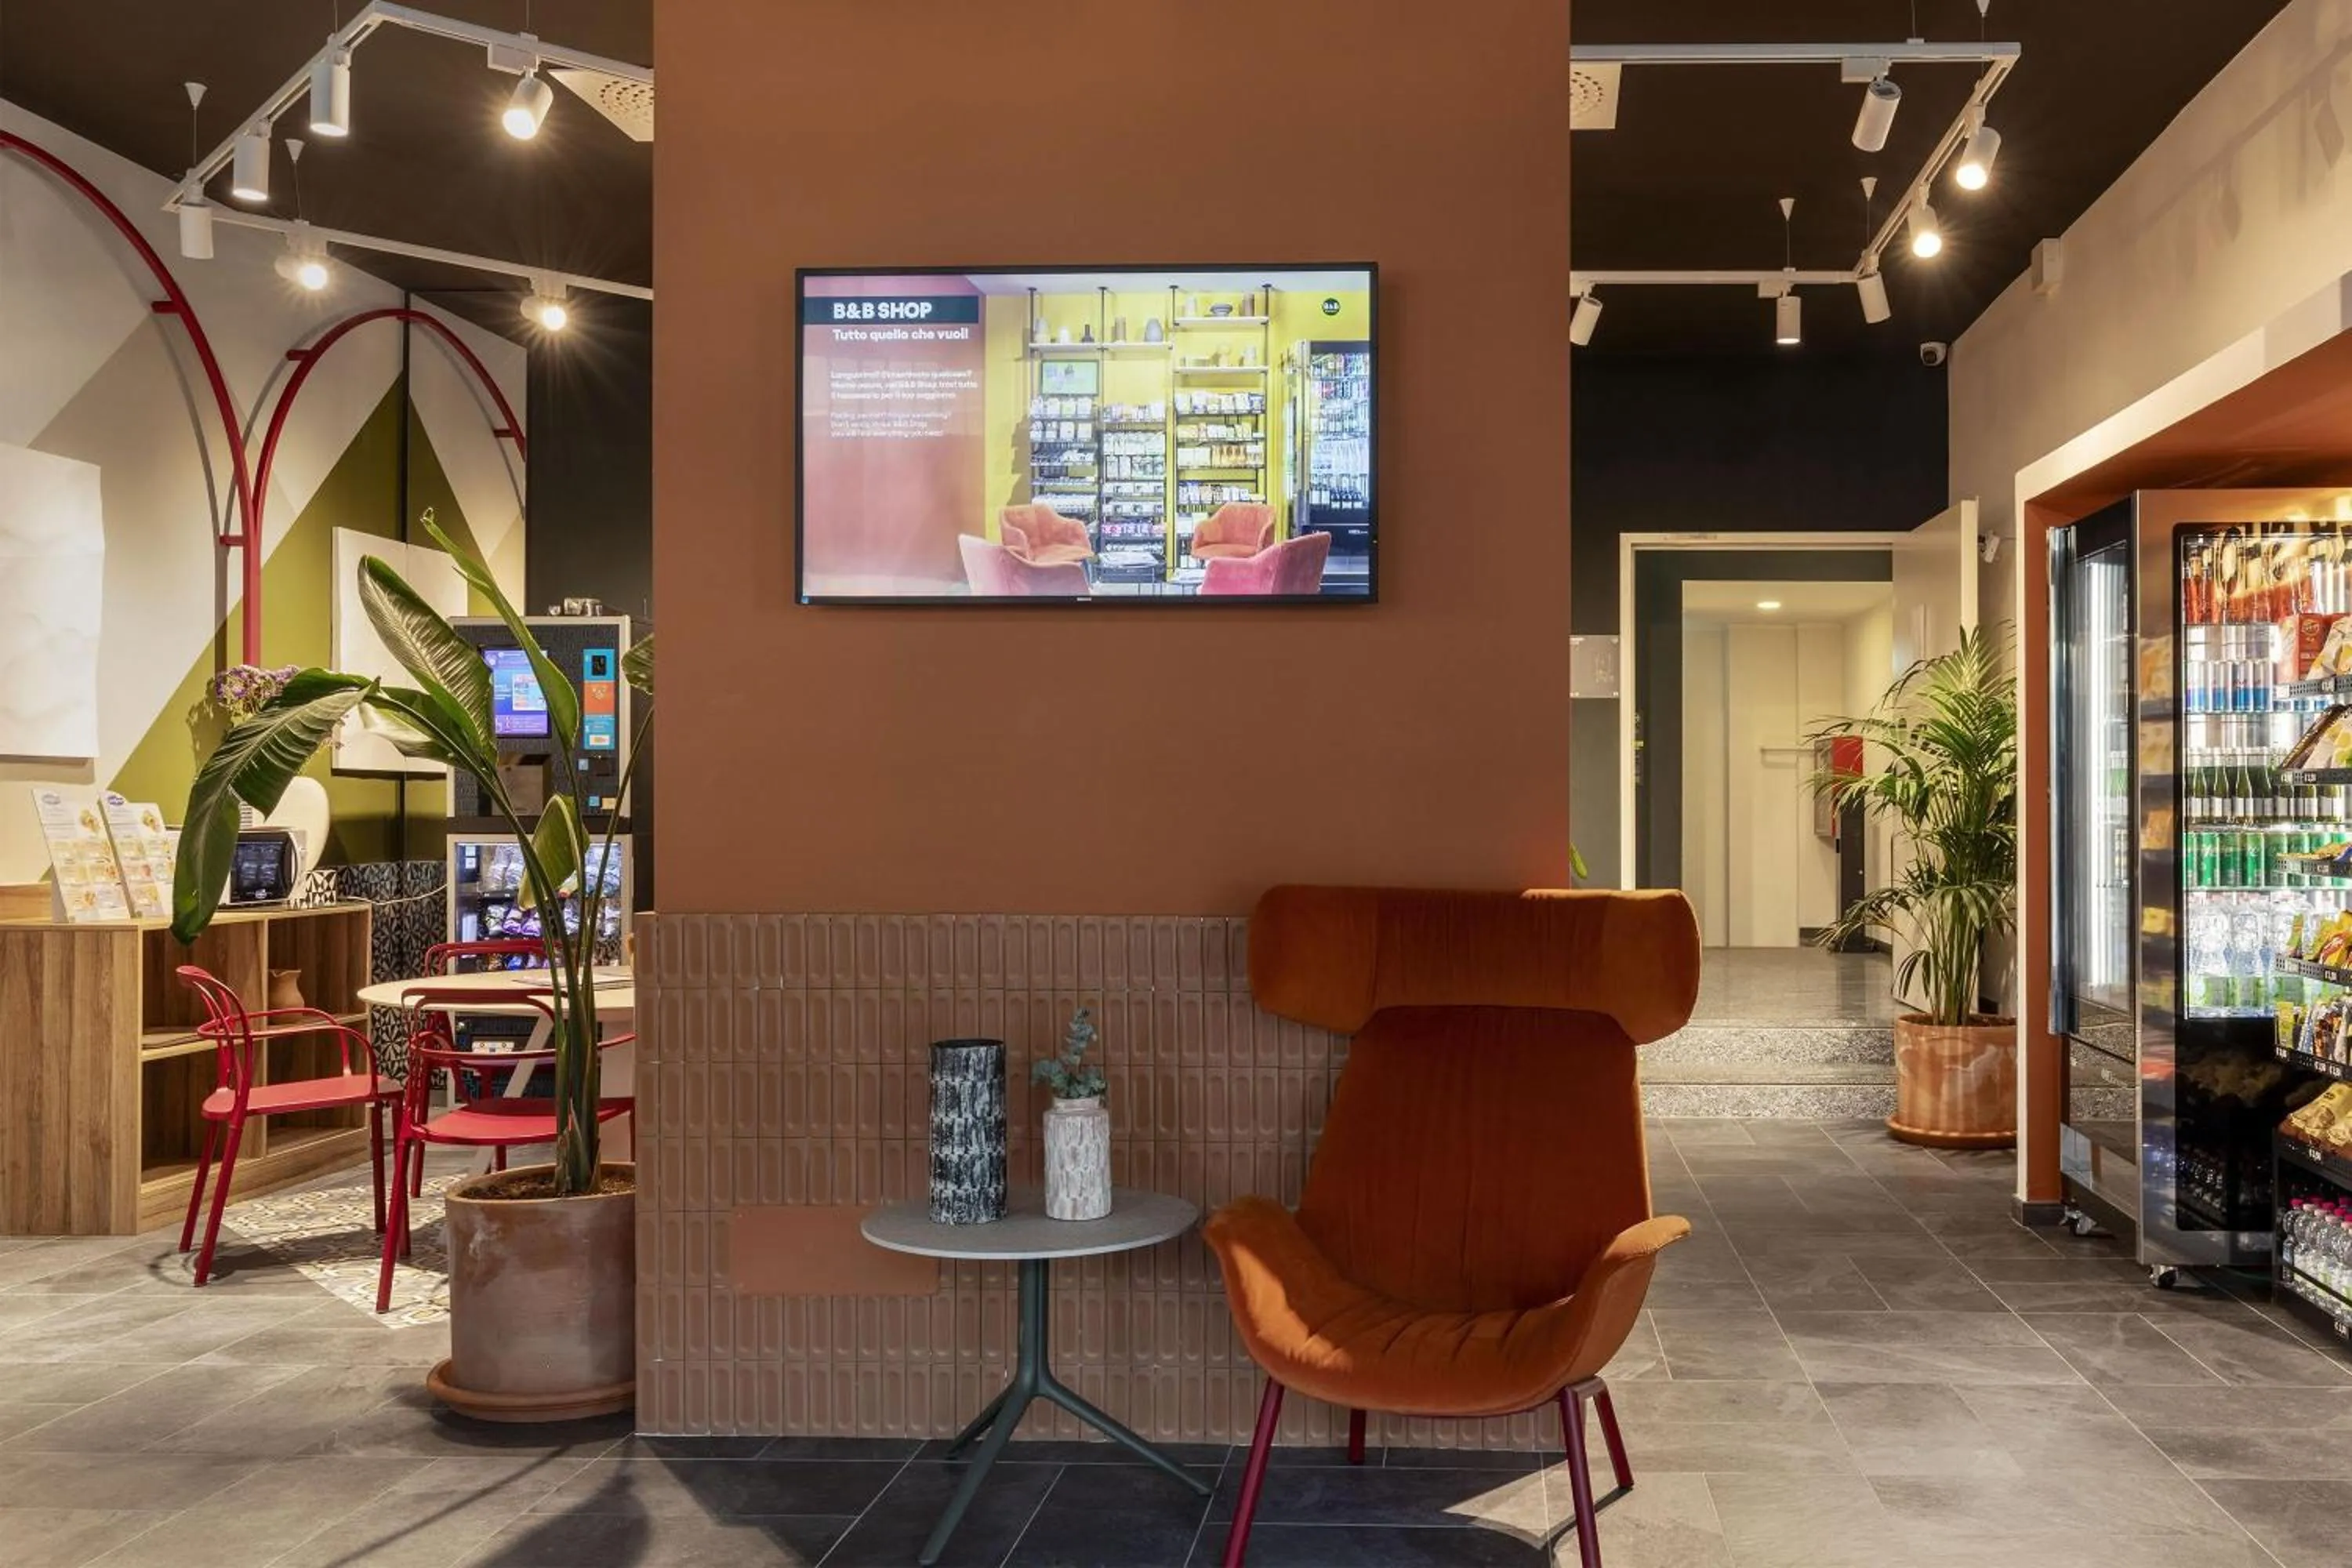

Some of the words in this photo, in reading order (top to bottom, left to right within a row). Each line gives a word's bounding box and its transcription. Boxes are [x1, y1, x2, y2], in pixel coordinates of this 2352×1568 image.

[833, 302, 875, 319] B&B
[878, 302, 932, 319] SHOP
[833, 328, 867, 340] Tutto
[869, 328, 909, 343] quello
[912, 328, 935, 339] che
